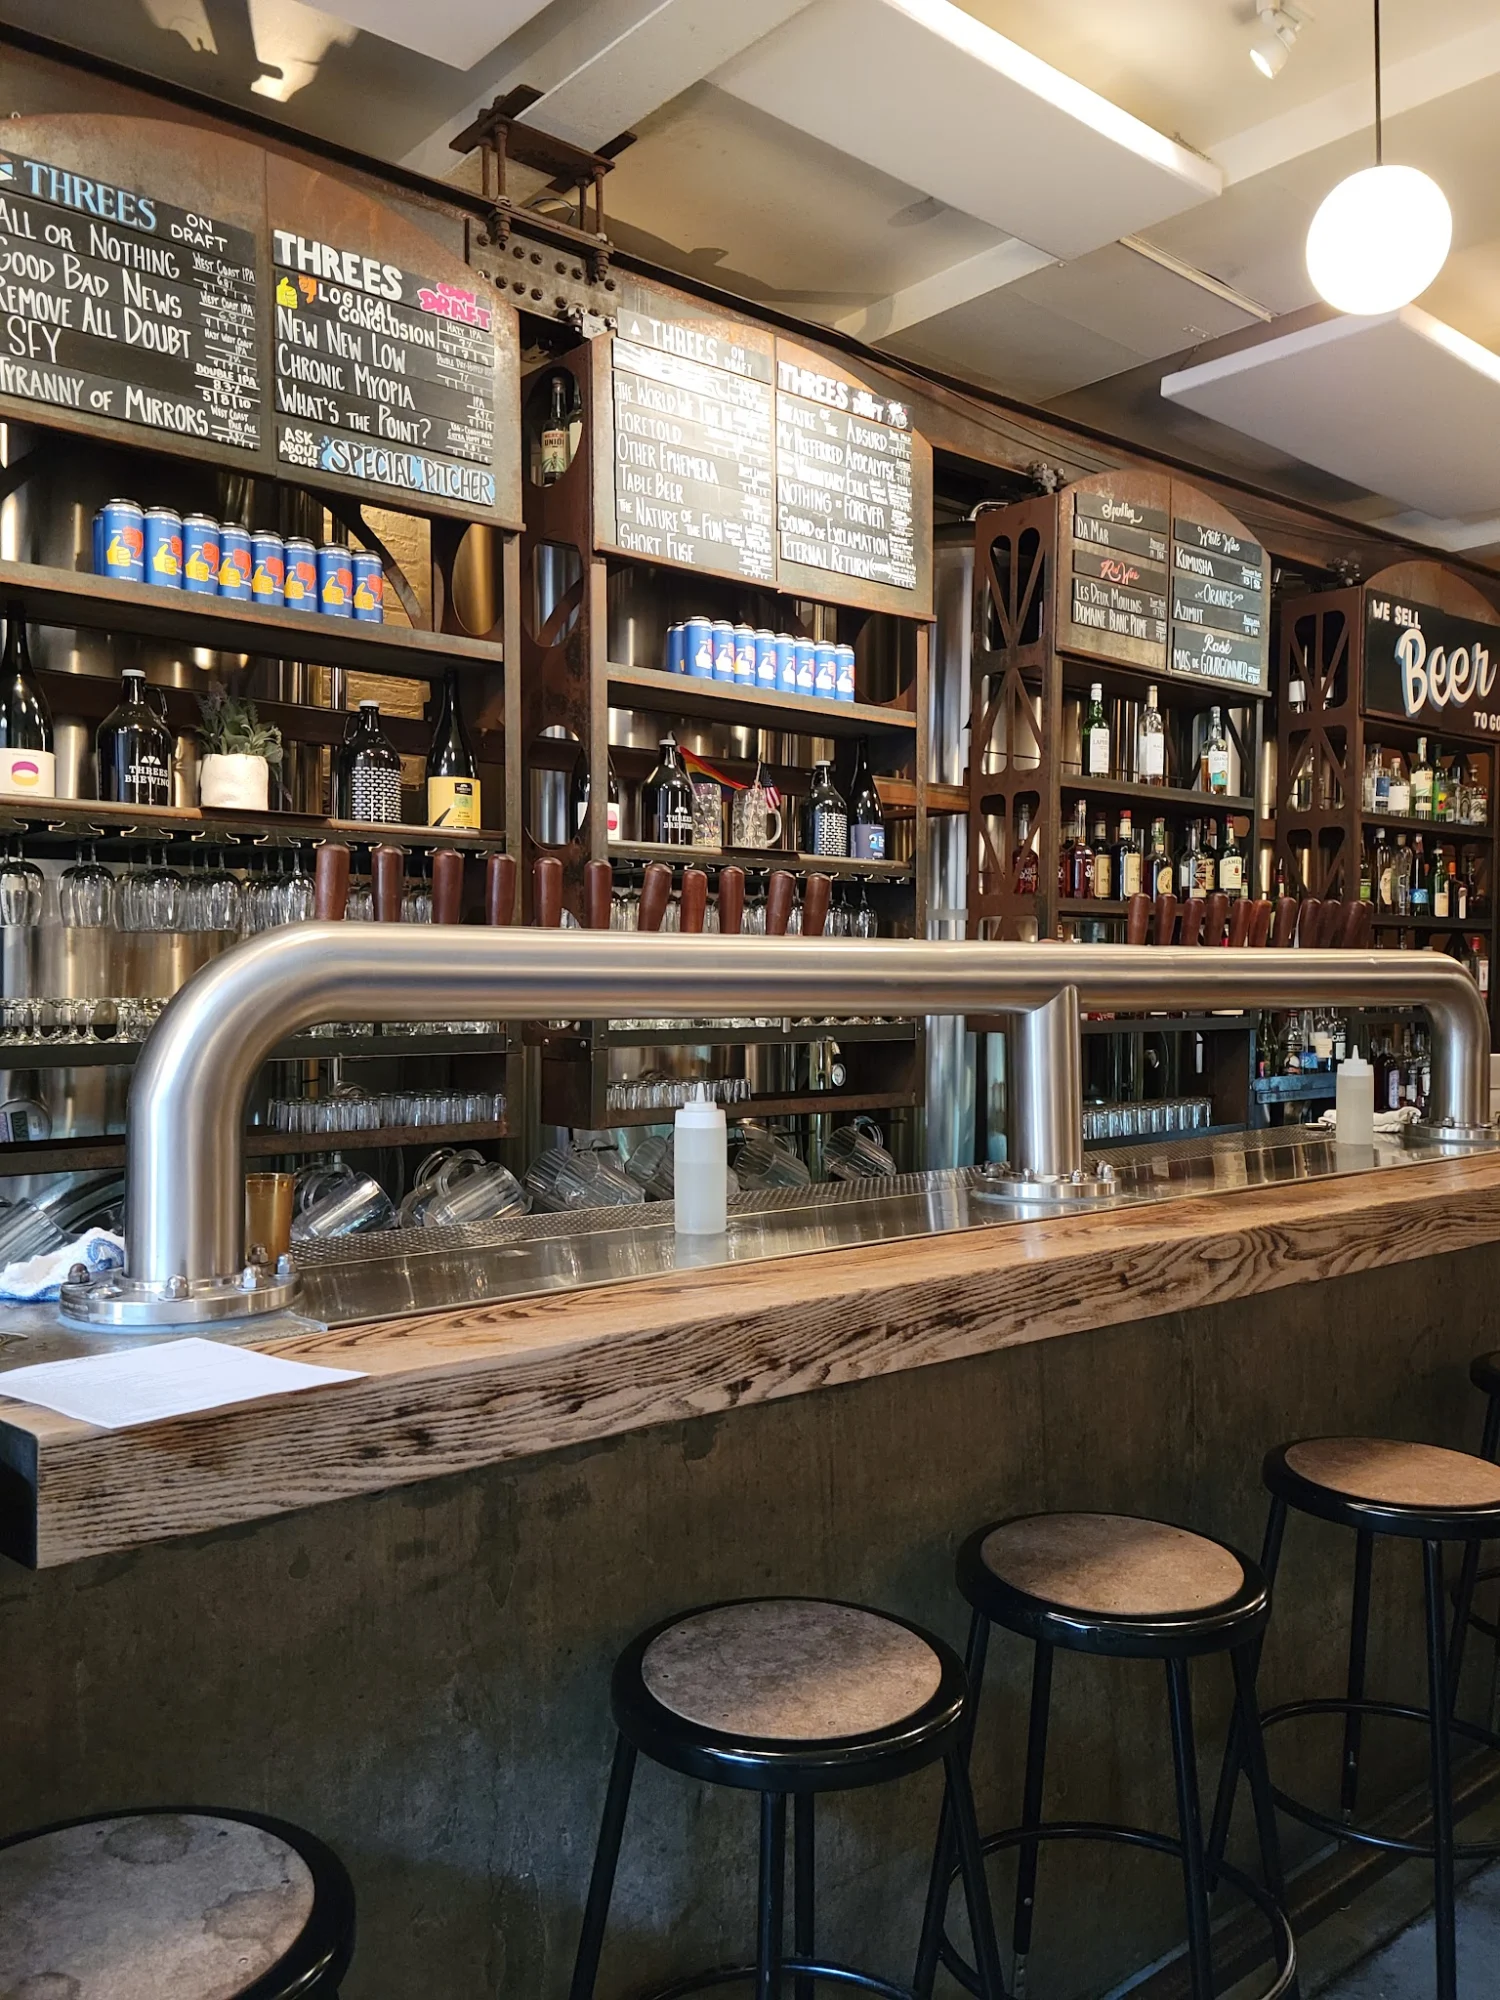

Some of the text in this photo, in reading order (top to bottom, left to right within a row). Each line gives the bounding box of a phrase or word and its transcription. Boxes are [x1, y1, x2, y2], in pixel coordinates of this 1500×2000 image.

[23, 160, 156, 231] THREES
[0, 198, 180, 279] ALL OR NOTHING
[171, 223, 228, 252] DRAFT
[186, 213, 213, 233] ON
[192, 252, 255, 282] WEST COAST IPA
[273, 228, 403, 301] THREES
[63, 253, 109, 298] BAD
[122, 268, 183, 319] NEWS
[318, 282, 394, 321] LOGICAL
[200, 290, 253, 317] WEST COAST IPA
[417, 288, 491, 330] DRAFT
[7, 315, 61, 364] SFY
[82, 296, 118, 339] ALL
[124, 306, 192, 359] DOUBT
[221, 332, 236, 344] WEST
[277, 307, 406, 375] NEW NEW LOW
[338, 304, 435, 349] CONCLUSION
[446, 321, 482, 341] HAZY IPA
[649, 319, 718, 365] THREES
[235, 345, 247, 357] IPA
[724, 356, 752, 377] DRAFT
[730, 346, 745, 361] ON
[195, 363, 257, 388] DOUBLE IPA
[277, 343, 416, 411] CHRONIC MYOPIA
[778, 361, 849, 410] THREES
[0, 356, 209, 437] TYRANNY OF MIRRORS
[277, 378, 432, 446] WHAT'S THE POINT?
[472, 396, 485, 408] IPA
[615, 381, 633, 403] THE
[636, 377, 676, 414] WORLD
[210, 404, 249, 422] WEST COAST
[618, 400, 683, 445] FORETOLD
[279, 440, 321, 459] ABOUT
[284, 427, 314, 445] ASK
[846, 418, 888, 452] ABSURD
[289, 454, 317, 469] OUR
[330, 439, 492, 504] SPECIAL PITCHER
[617, 432, 657, 469] OTHER
[660, 442, 719, 485] EPHEMERA
[794, 429, 844, 466] PREFERRED
[846, 443, 896, 482] APOCALYPSE
[619, 463, 684, 505] TABLE BEER
[846, 469, 870, 500] EXILE
[617, 498, 633, 514] THE
[635, 497, 680, 534] NATURE
[681, 509, 693, 525] OF
[778, 476, 832, 514] NOTHING
[843, 494, 885, 530] FOREVER
[619, 523, 662, 556] SHORT
[666, 532, 696, 565] FUSE
[684, 523, 701, 538] THE
[702, 513, 723, 543] FUN
[779, 505, 814, 537] SOUND
[815, 527, 826, 541] OF
[826, 518, 889, 558] EXCLAMATION
[1077, 516, 1109, 545] DA MAR
[1197, 525, 1240, 554] White Wine
[781, 532, 829, 570] ETERNAL
[831, 544, 870, 578] RETURN
[1176, 546, 1214, 577] KUMUSHA
[1076, 579, 1089, 601] LES
[1090, 582, 1110, 607] DEUX
[1111, 587, 1142, 614] MOULINS
[1174, 599, 1204, 624] AZIMUT
[1203, 583, 1235, 609] ORANGE
[1074, 600, 1107, 629] DOMAINE
[1109, 608, 1129, 634] BLANC
[1372, 599, 1422, 630] WE SELL
[1173, 648, 1191, 672] MAS
[1191, 657, 1200, 669] DE
[1394, 628, 1498, 719] Beer
[1473, 711, 1500, 733] TO GO
[128, 765, 168, 778] THREES
